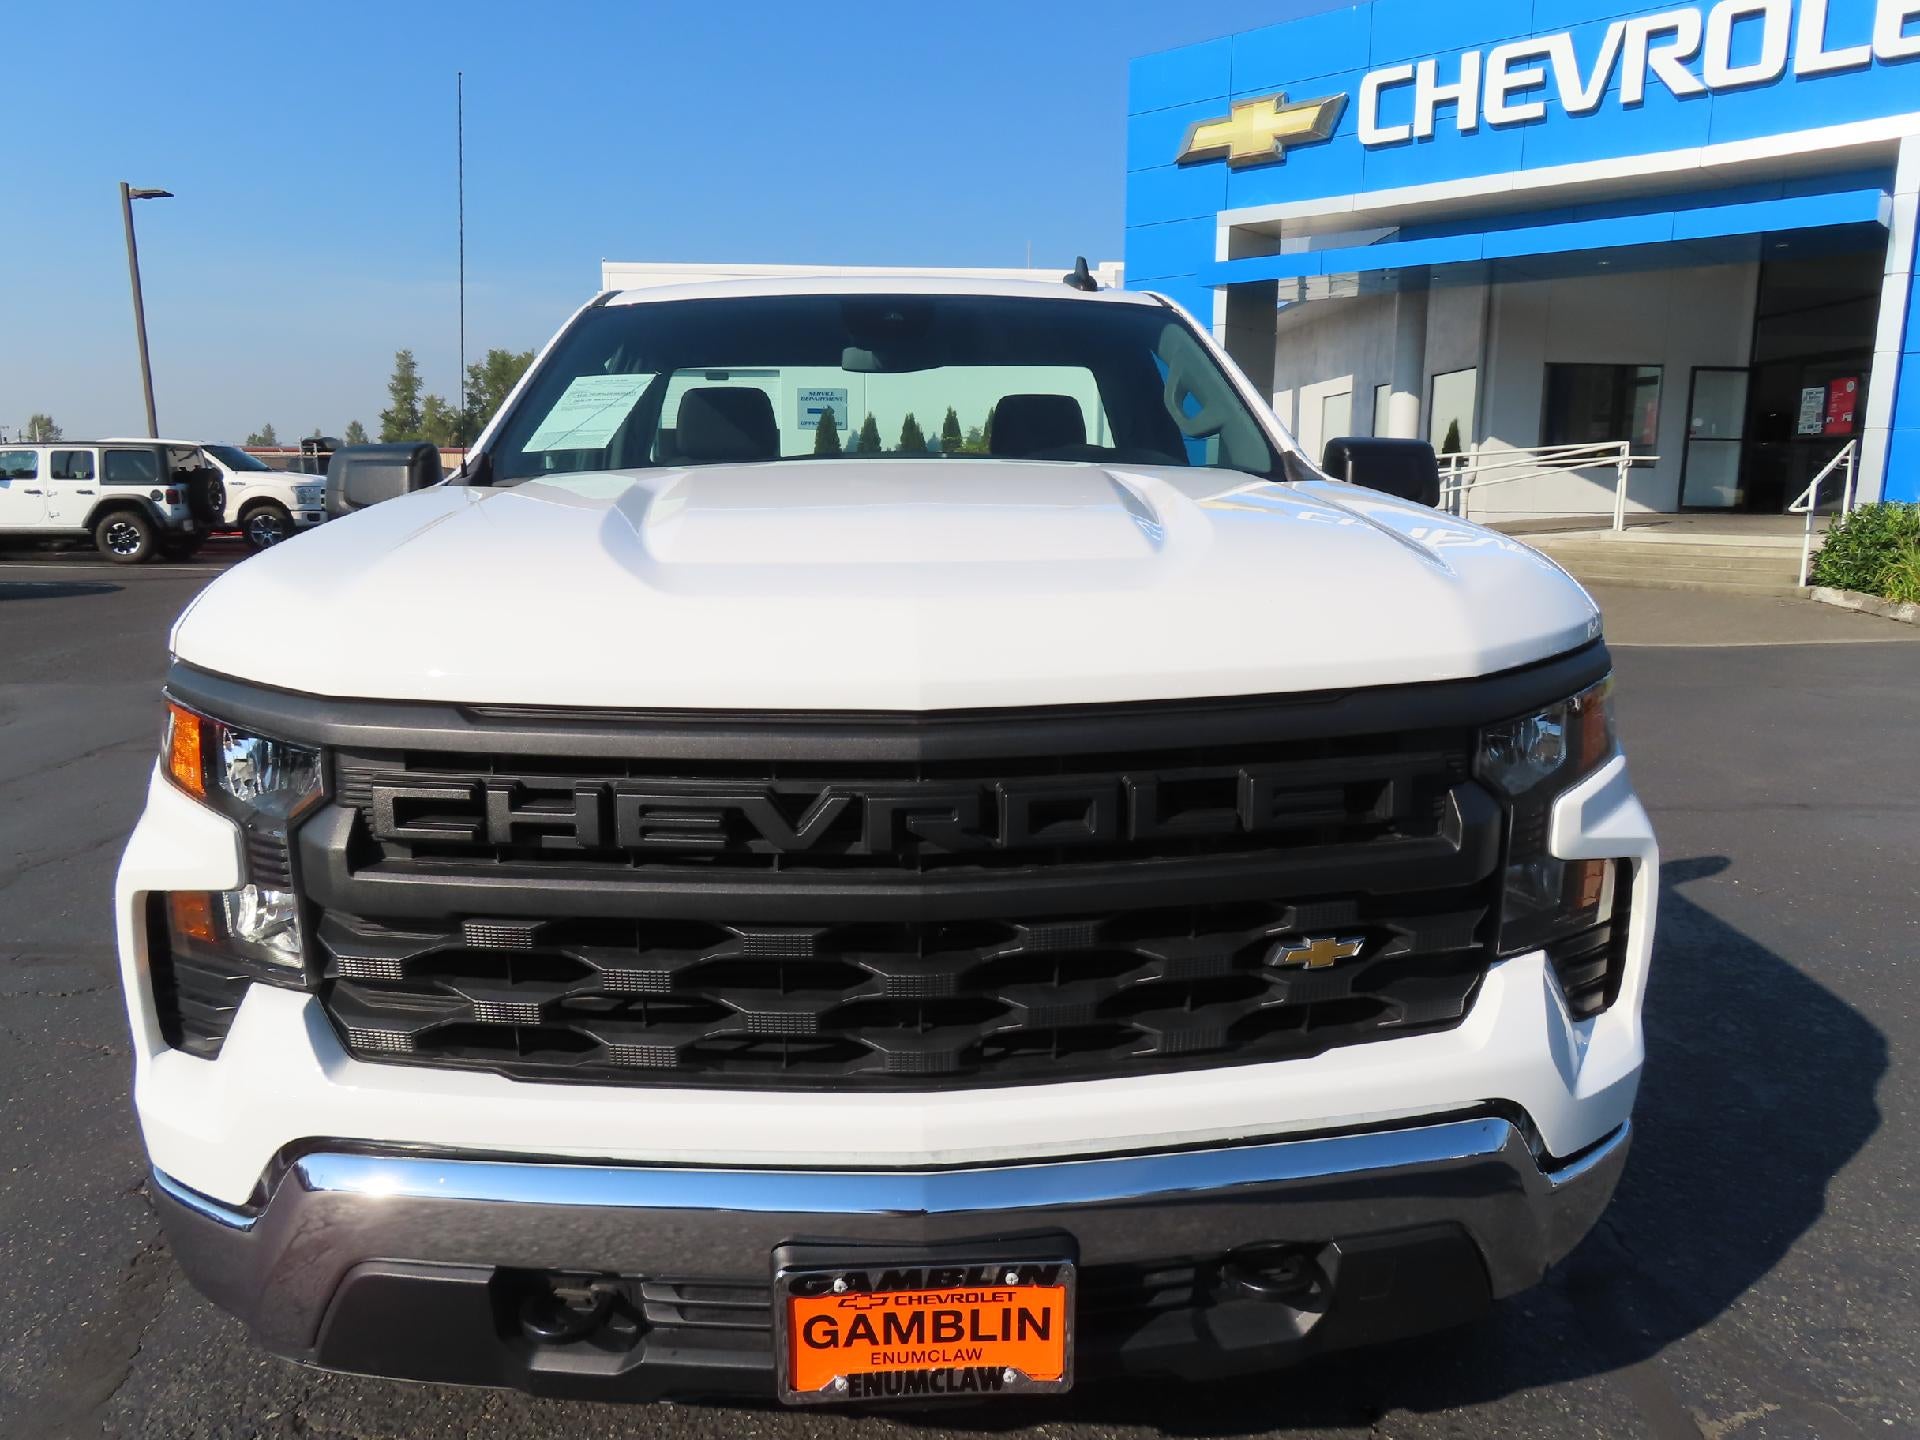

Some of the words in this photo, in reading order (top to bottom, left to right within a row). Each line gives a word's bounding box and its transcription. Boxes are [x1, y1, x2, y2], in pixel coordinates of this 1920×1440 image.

[371, 770, 1438, 854] CHEVROLET
[894, 1291, 1017, 1307] CHEVROLET
[802, 1306, 1051, 1350] GAMBLIN
[871, 1348, 983, 1366] ENUMCLAW
[848, 1366, 1006, 1398] ENUMCLAW
